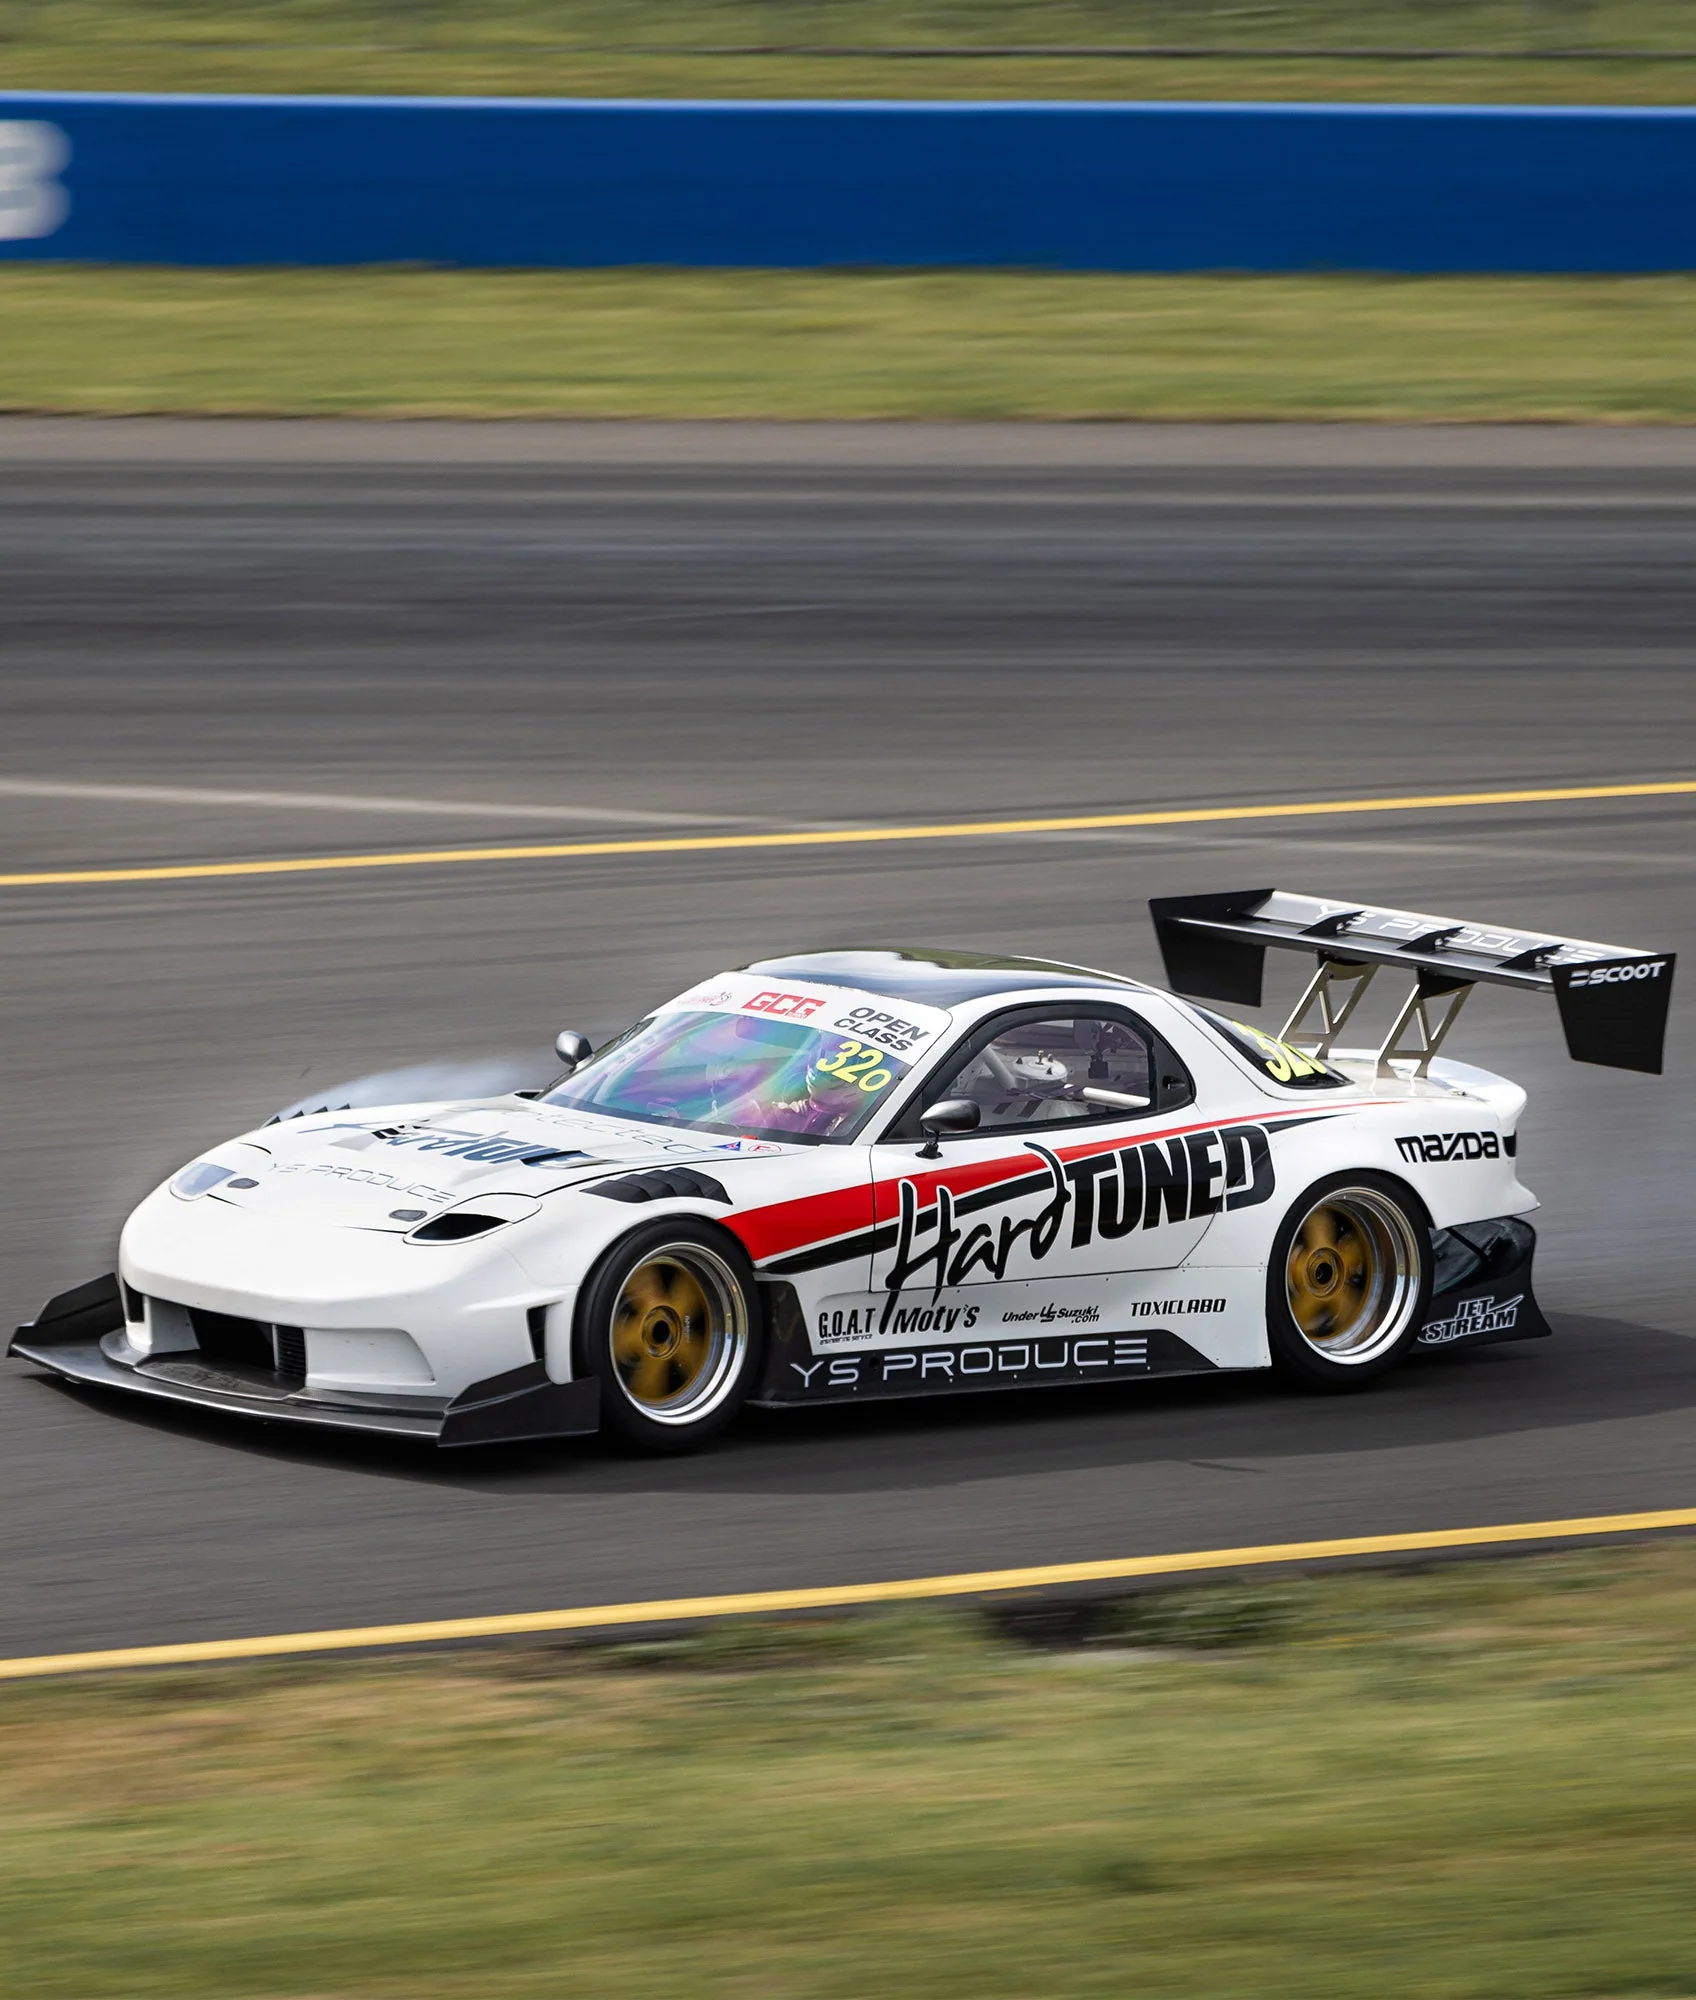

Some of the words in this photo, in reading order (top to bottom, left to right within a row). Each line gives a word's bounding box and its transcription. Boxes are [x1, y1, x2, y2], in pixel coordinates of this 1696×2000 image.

[741, 991, 827, 1018] GCG
[834, 1018, 913, 1051] CLASS
[849, 1007, 929, 1041] OPEN
[816, 1040, 892, 1092] 320
[306, 1164, 457, 1203] PRODUCE
[818, 1308, 876, 1339] G.O.A.T
[1131, 1298, 1227, 1317] TOXICLABO
[1455, 1296, 1494, 1320] JET
[1425, 1308, 1517, 1342] STREAM
[791, 1357, 861, 1388] YS
[882, 1338, 1148, 1381] PRODUCE
